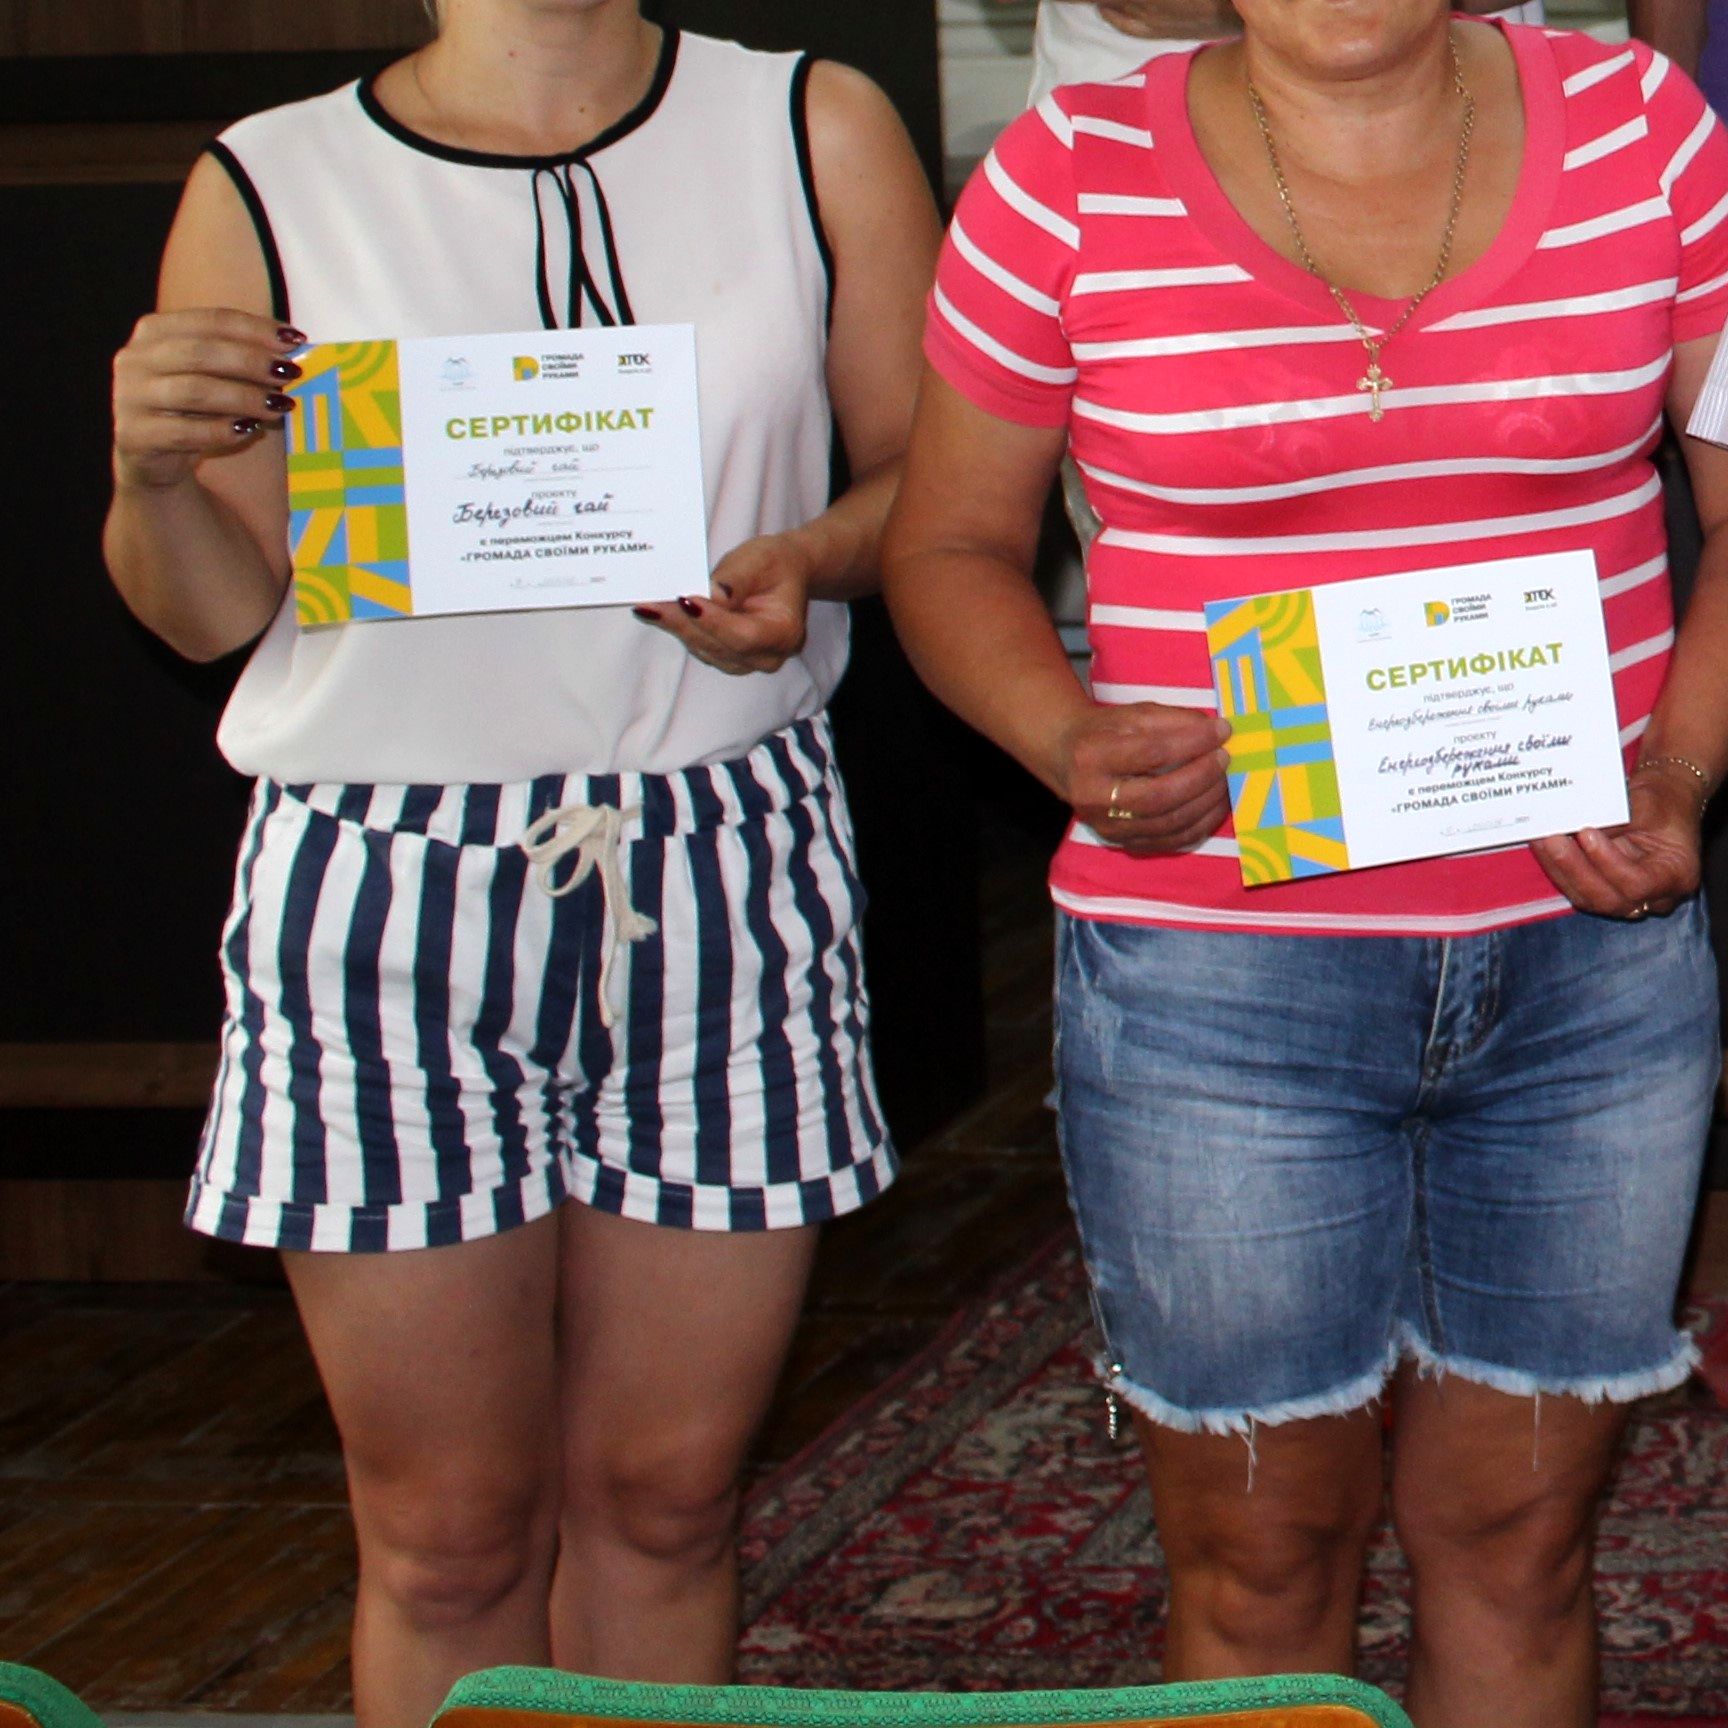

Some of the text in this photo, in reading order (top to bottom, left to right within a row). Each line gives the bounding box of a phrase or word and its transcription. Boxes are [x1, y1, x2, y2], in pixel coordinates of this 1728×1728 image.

[446, 408, 653, 439] СЕРТИФІКАТ
[504, 444, 599, 456] підтверджує, що
[532, 490, 577, 500] проєкту
[453, 494, 614, 528] Березовий гай
[490, 533, 572, 546] переможцем
[575, 530, 632, 541] Конкурсу
[460, 543, 653, 561] «ГРОМАДА СВОЇМИ РУКАМИ»
[1366, 643, 1563, 691] СЕРТИФІКАТ
[1423, 683, 1514, 703] підтверджує, що
[1454, 730, 1496, 744] проєкту
[1417, 776, 1496, 794] переможцем
[1498, 767, 1553, 781] Конкурсу
[1391, 779, 1573, 813] «ГРОМАДА СВОЇМИ РУКАМИ»
